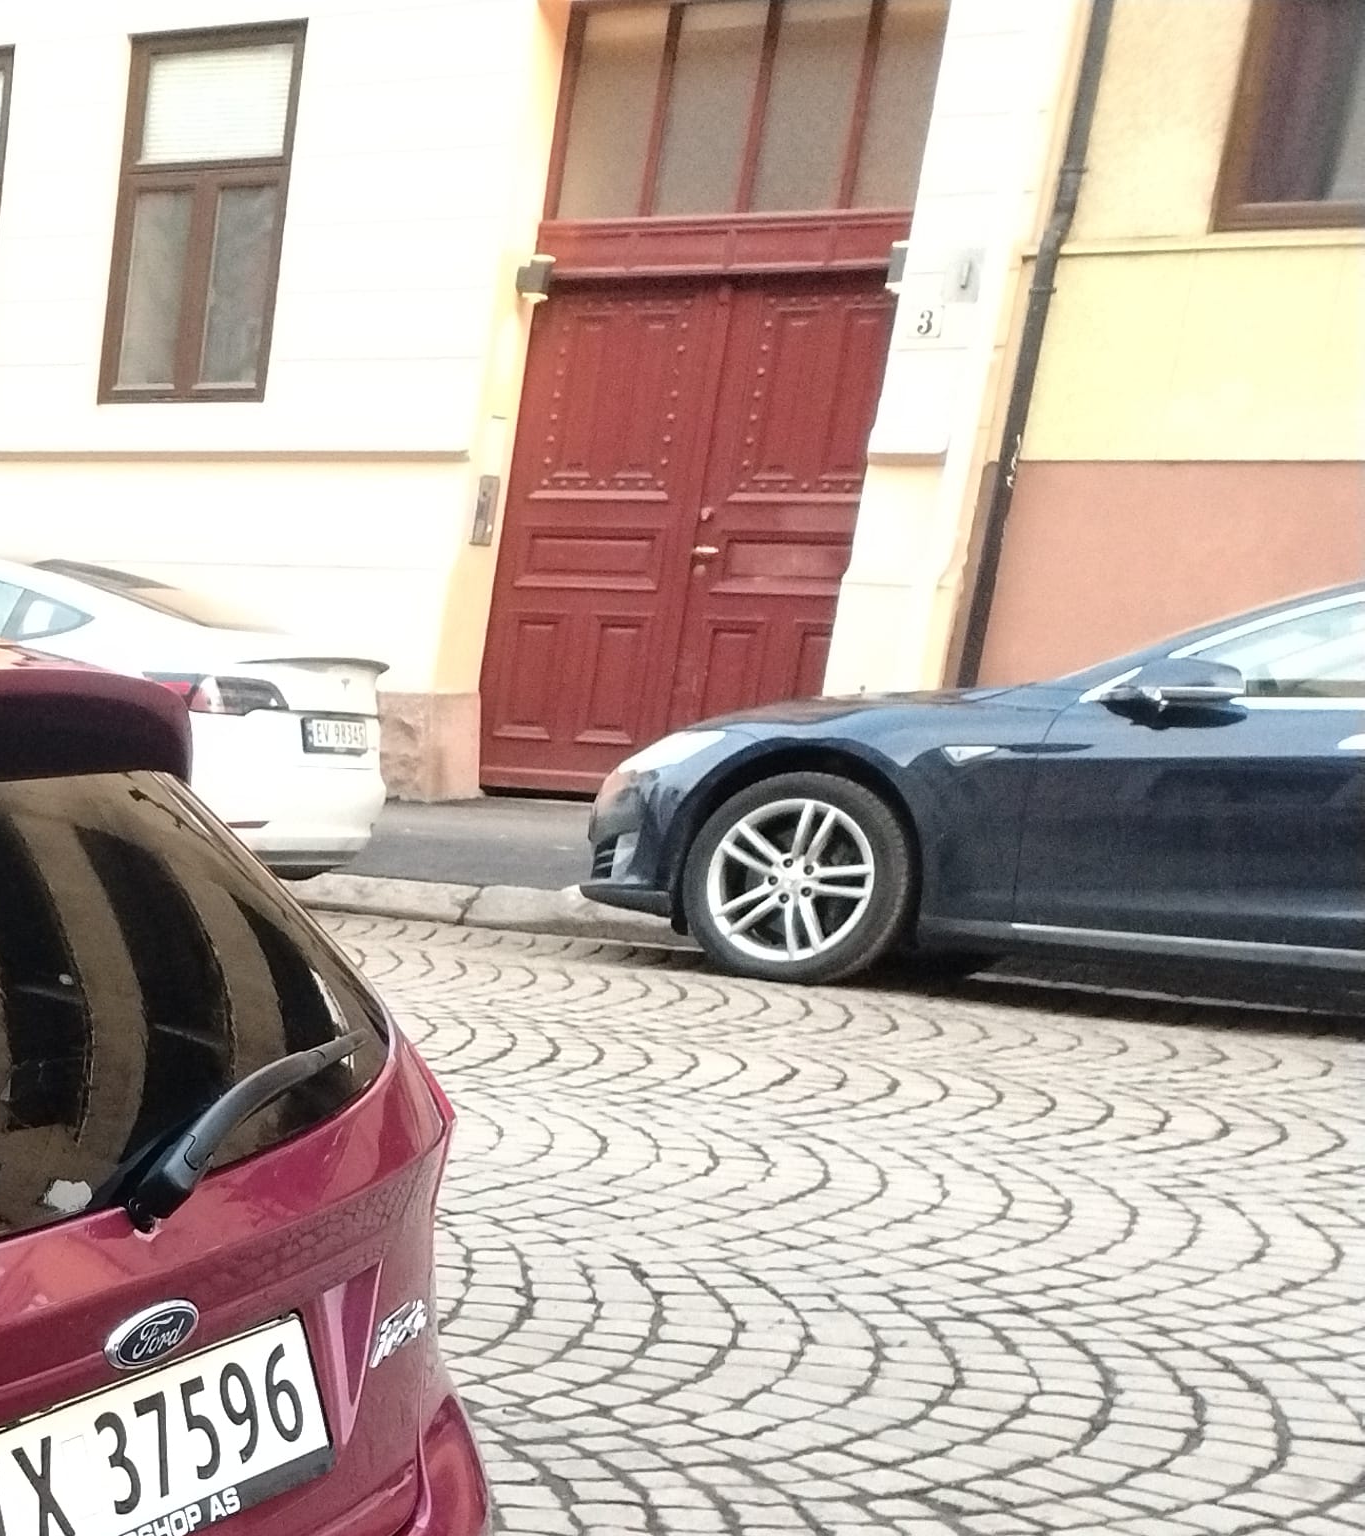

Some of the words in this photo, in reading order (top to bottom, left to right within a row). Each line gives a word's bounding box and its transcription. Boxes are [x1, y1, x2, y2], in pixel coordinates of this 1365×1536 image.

[917, 310, 933, 335] 3
[316, 723, 330, 743] EV
[132, 1315, 185, 1360] Ford
[94, 1343, 304, 1515] 37596
[210, 1486, 241, 1522] AS
